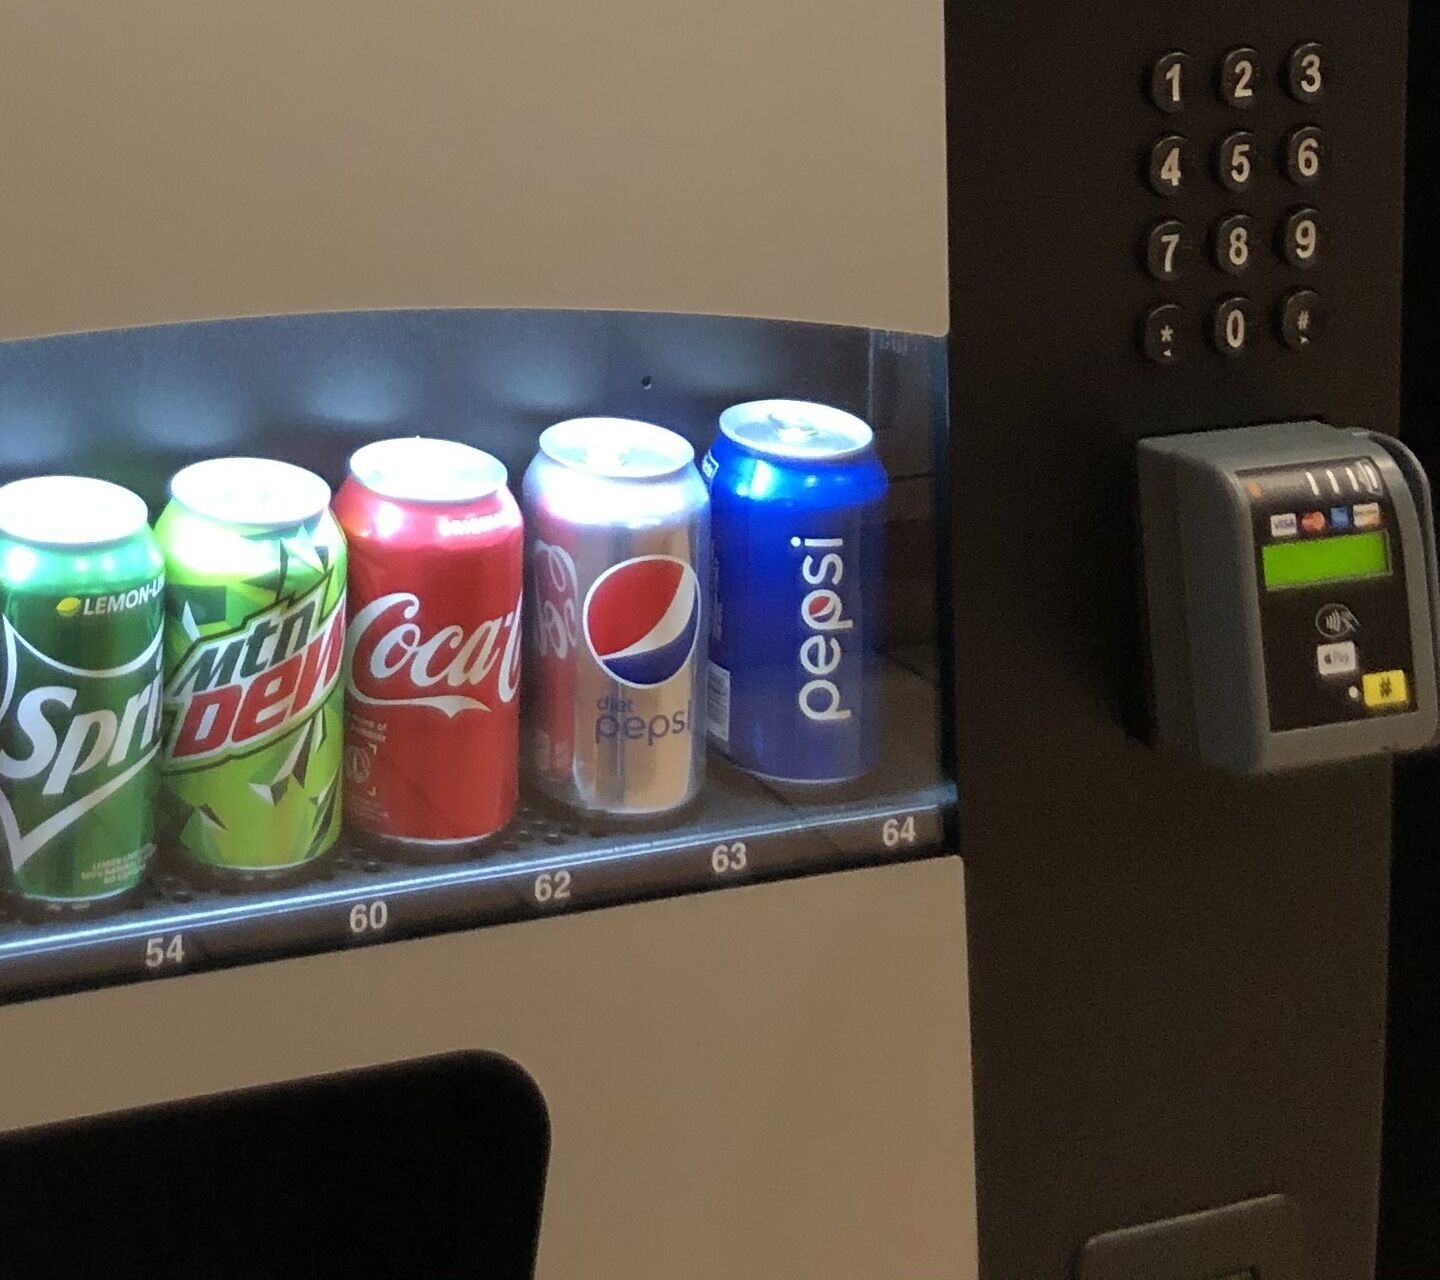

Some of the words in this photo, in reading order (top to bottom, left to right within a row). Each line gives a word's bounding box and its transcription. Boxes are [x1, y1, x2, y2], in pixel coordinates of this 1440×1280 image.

[1166, 63, 1181, 102] 1
[1234, 60, 1253, 98] 2
[1301, 54, 1322, 93] 3
[1160, 147, 1182, 187] 4
[1231, 144, 1250, 183] 5
[1298, 138, 1319, 177] 6
[1161, 233, 1180, 273] 7
[1229, 227, 1249, 266] 8
[1295, 220, 1316, 259] 9
[1226, 309, 1245, 348] 0
[790, 536, 853, 722] pepsi
[175, 601, 316, 698] Mtn
[597, 695, 633, 714] diet
[882, 816, 916, 847] 64
[711, 843, 747, 874] 63
[534, 870, 572, 901] 62
[349, 901, 388, 933] 60
[145, 934, 185, 968] 54
